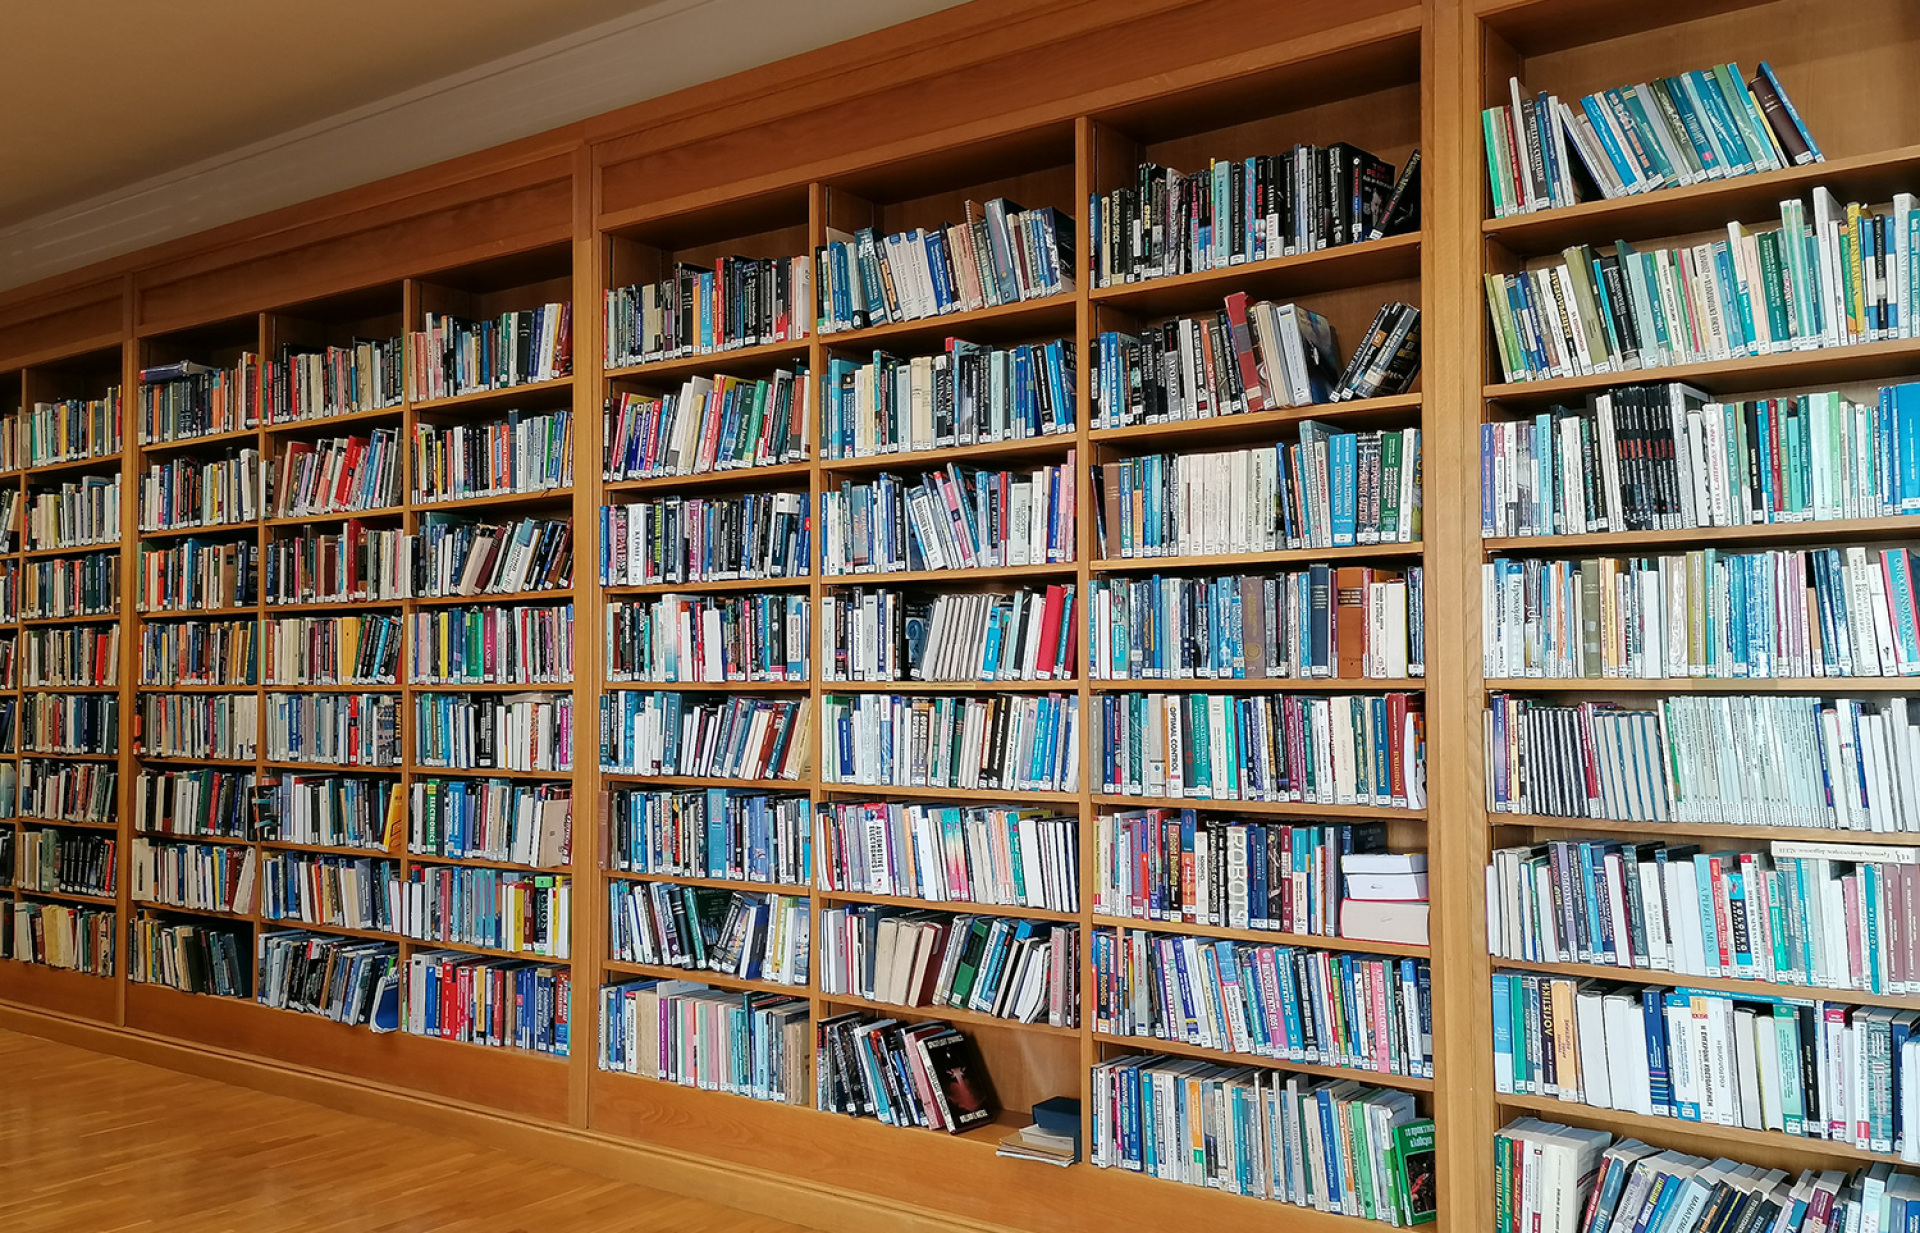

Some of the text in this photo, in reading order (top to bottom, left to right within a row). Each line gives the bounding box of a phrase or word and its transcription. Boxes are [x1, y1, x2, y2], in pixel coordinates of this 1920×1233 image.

[937, 375, 945, 411] WINGS
[1169, 359, 1177, 396] APOLLO
[738, 414, 750, 449] Signal Analysis
[654, 505, 662, 563] ANTENNA THEORY
[1170, 707, 1179, 772] OPTIMAL CONTROL
[662, 800, 670, 852] DIGITAL VIDEO
[869, 826, 877, 868] ELECTRONICS
[876, 825, 884, 868] AUTOMOTIVE
[1169, 832, 1179, 886] Robot Building
[540, 893, 548, 928] CMOS
[1211, 882, 1219, 913] ROBOTICS
[1706, 931, 1714, 953] MESS
[1735, 900, 1748, 951] SOLOING
[1100, 974, 1108, 1006] Robotics
[1395, 990, 1403, 1006] PIC
[1269, 1013, 1279, 1030] 8051
[1541, 981, 1553, 1037] ΛΟΓΙΣΤΙΚΗ
